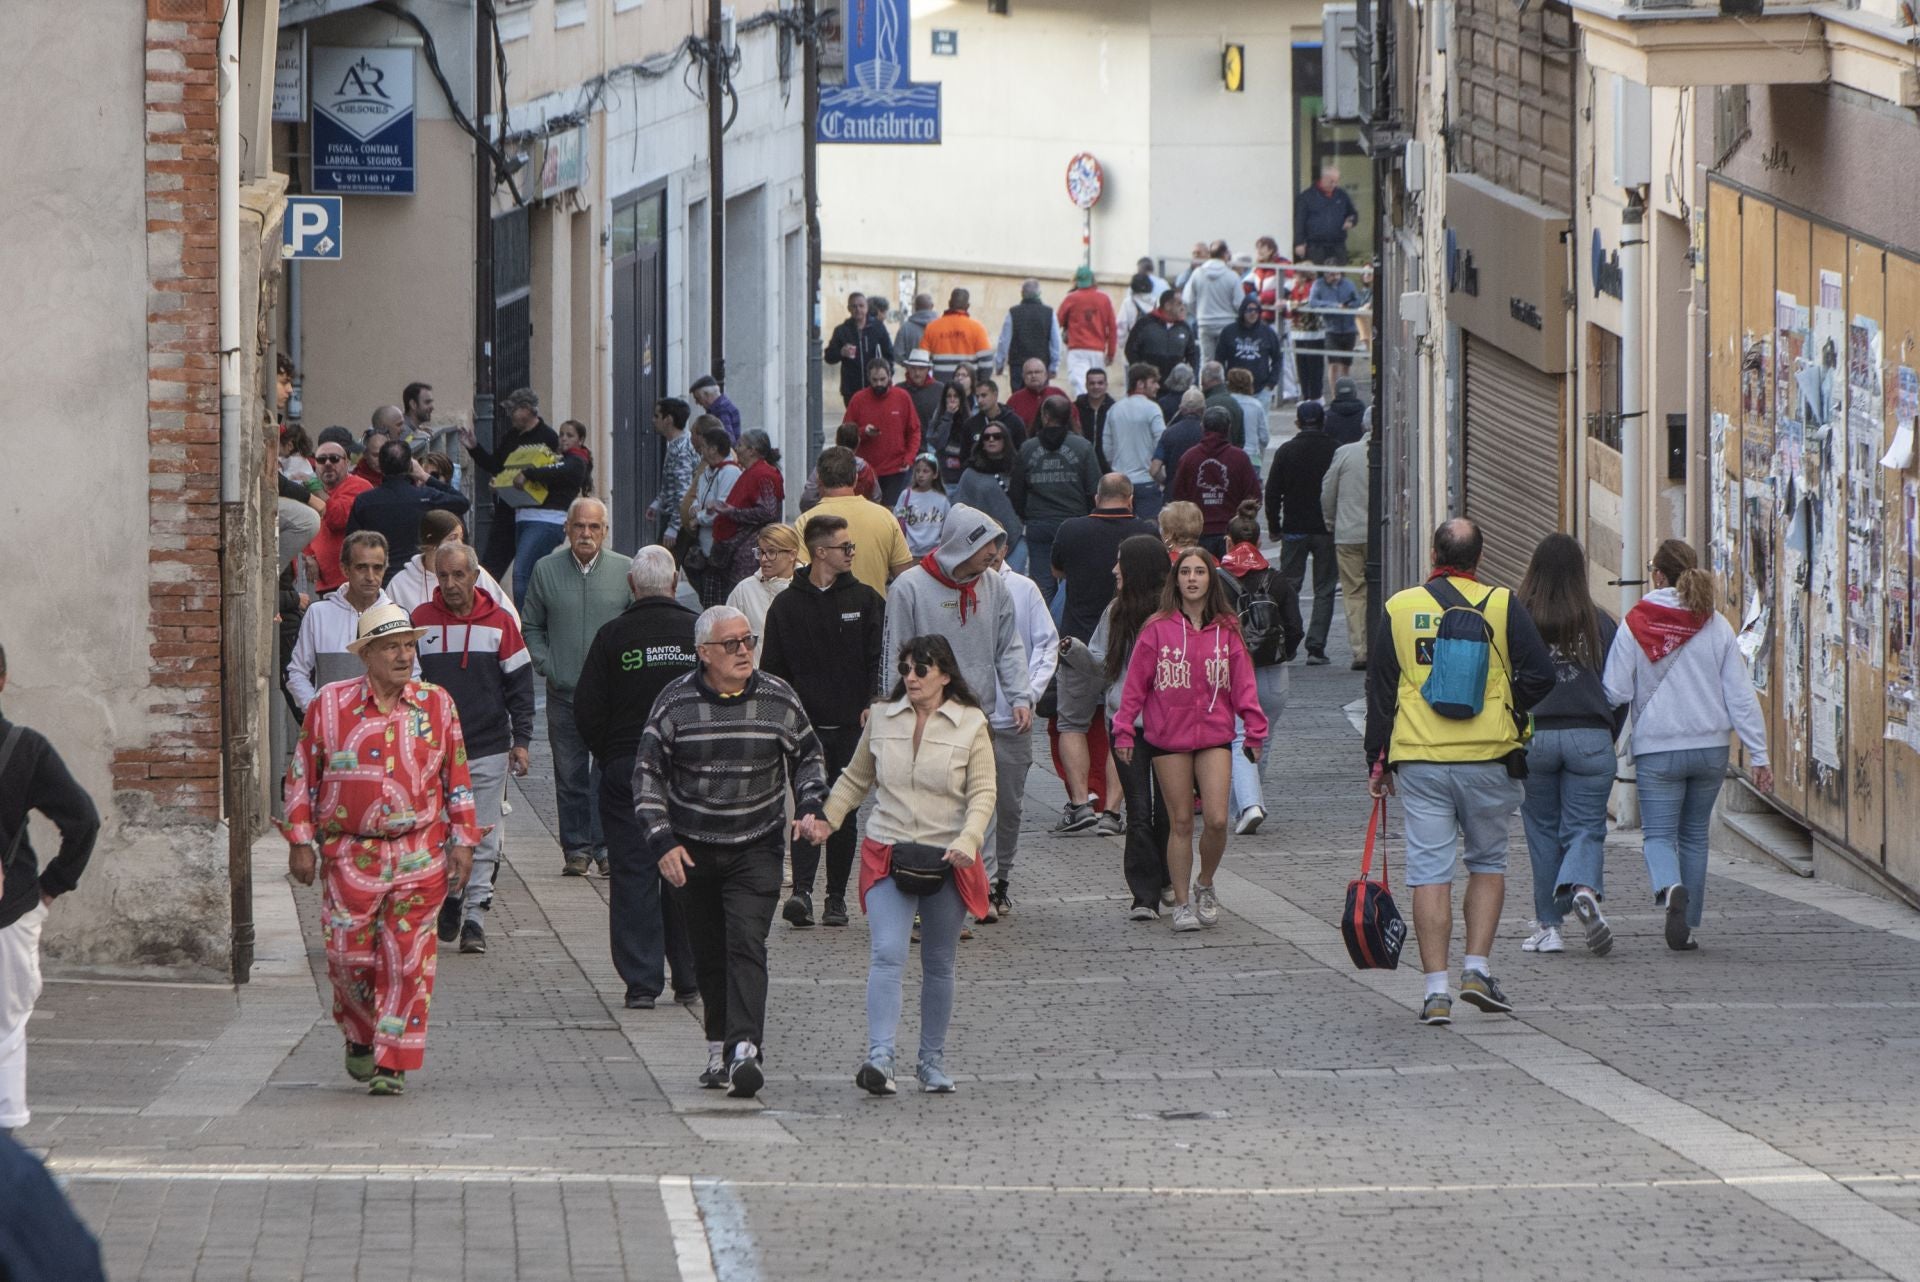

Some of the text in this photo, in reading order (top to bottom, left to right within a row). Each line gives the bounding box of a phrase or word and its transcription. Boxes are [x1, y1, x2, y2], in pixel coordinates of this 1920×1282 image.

[337, 105, 389, 114] ASESORES
[821, 110, 935, 139] Cantábrico
[328, 144, 353, 153] FISCAL
[360, 144, 399, 154] CONTABLE
[325, 156, 359, 165] LABORAL
[366, 156, 402, 166] SEGUROS
[346, 173, 396, 183] 921 140 147
[292, 204, 329, 251] P
[646, 645, 681, 655] SANTOS
[647, 653, 697, 662] BARTOLOMÉ
